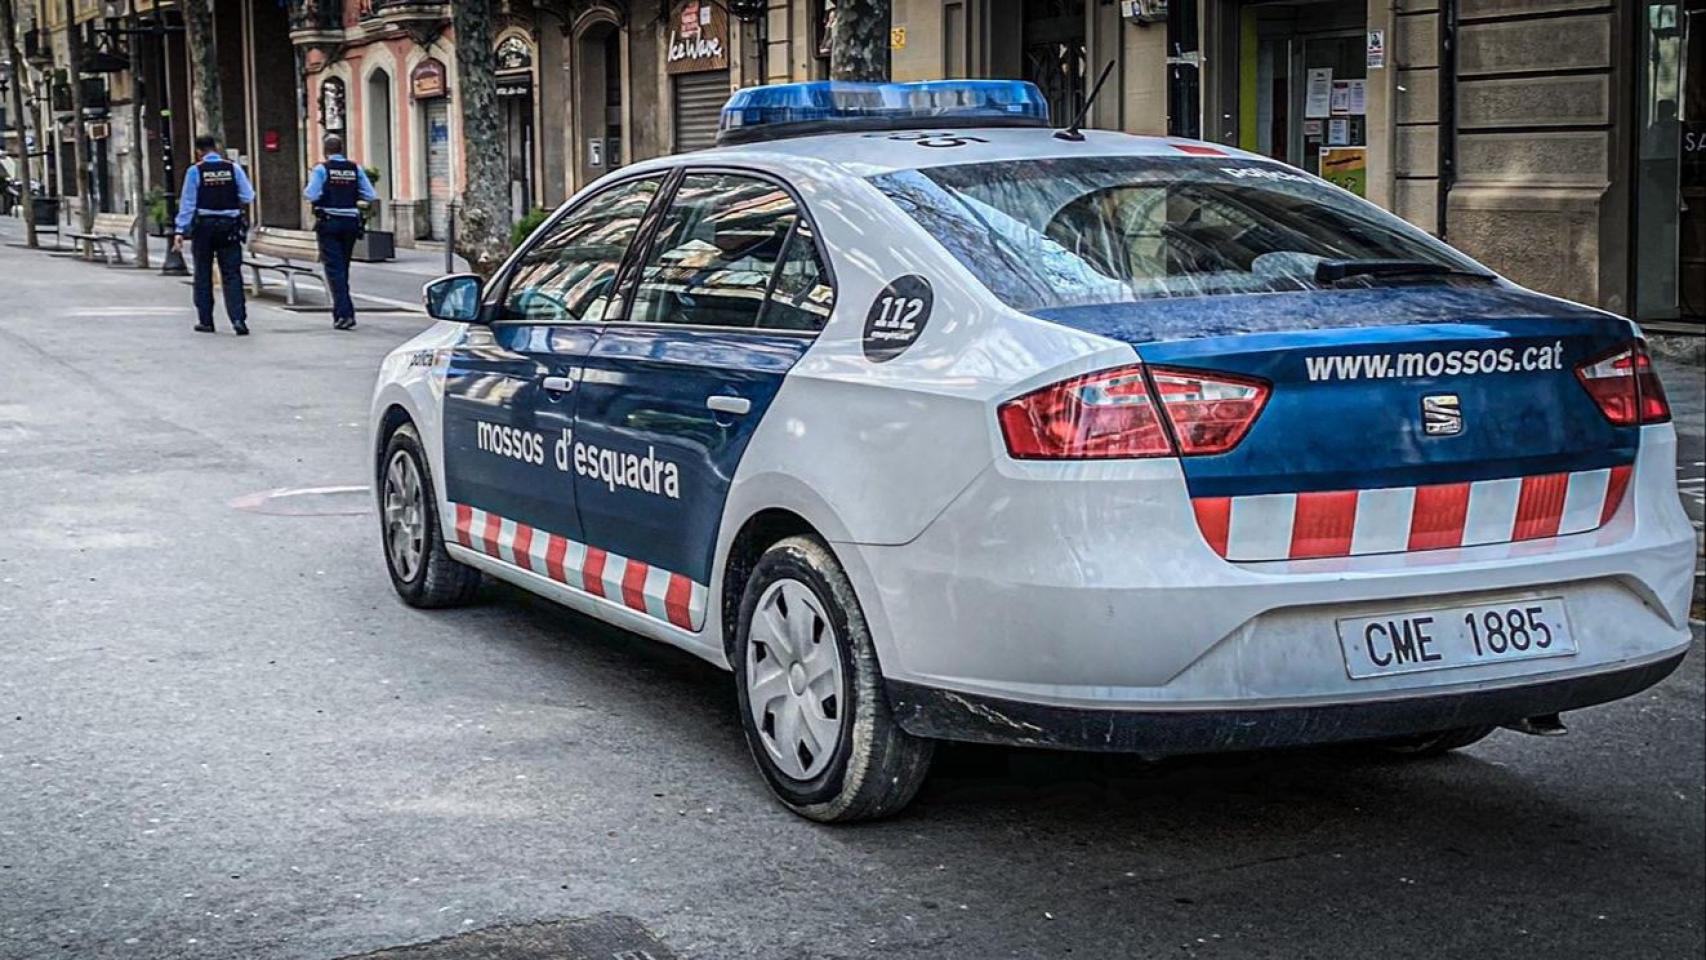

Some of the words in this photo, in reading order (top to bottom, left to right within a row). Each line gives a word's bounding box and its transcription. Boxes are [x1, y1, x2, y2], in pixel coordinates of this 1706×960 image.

[874, 297, 924, 330] 112
[1305, 340, 1564, 382] www.mossos.cat
[477, 420, 545, 466] mossos
[1365, 616, 1442, 667] CME
[1465, 607, 1552, 656] 1885
